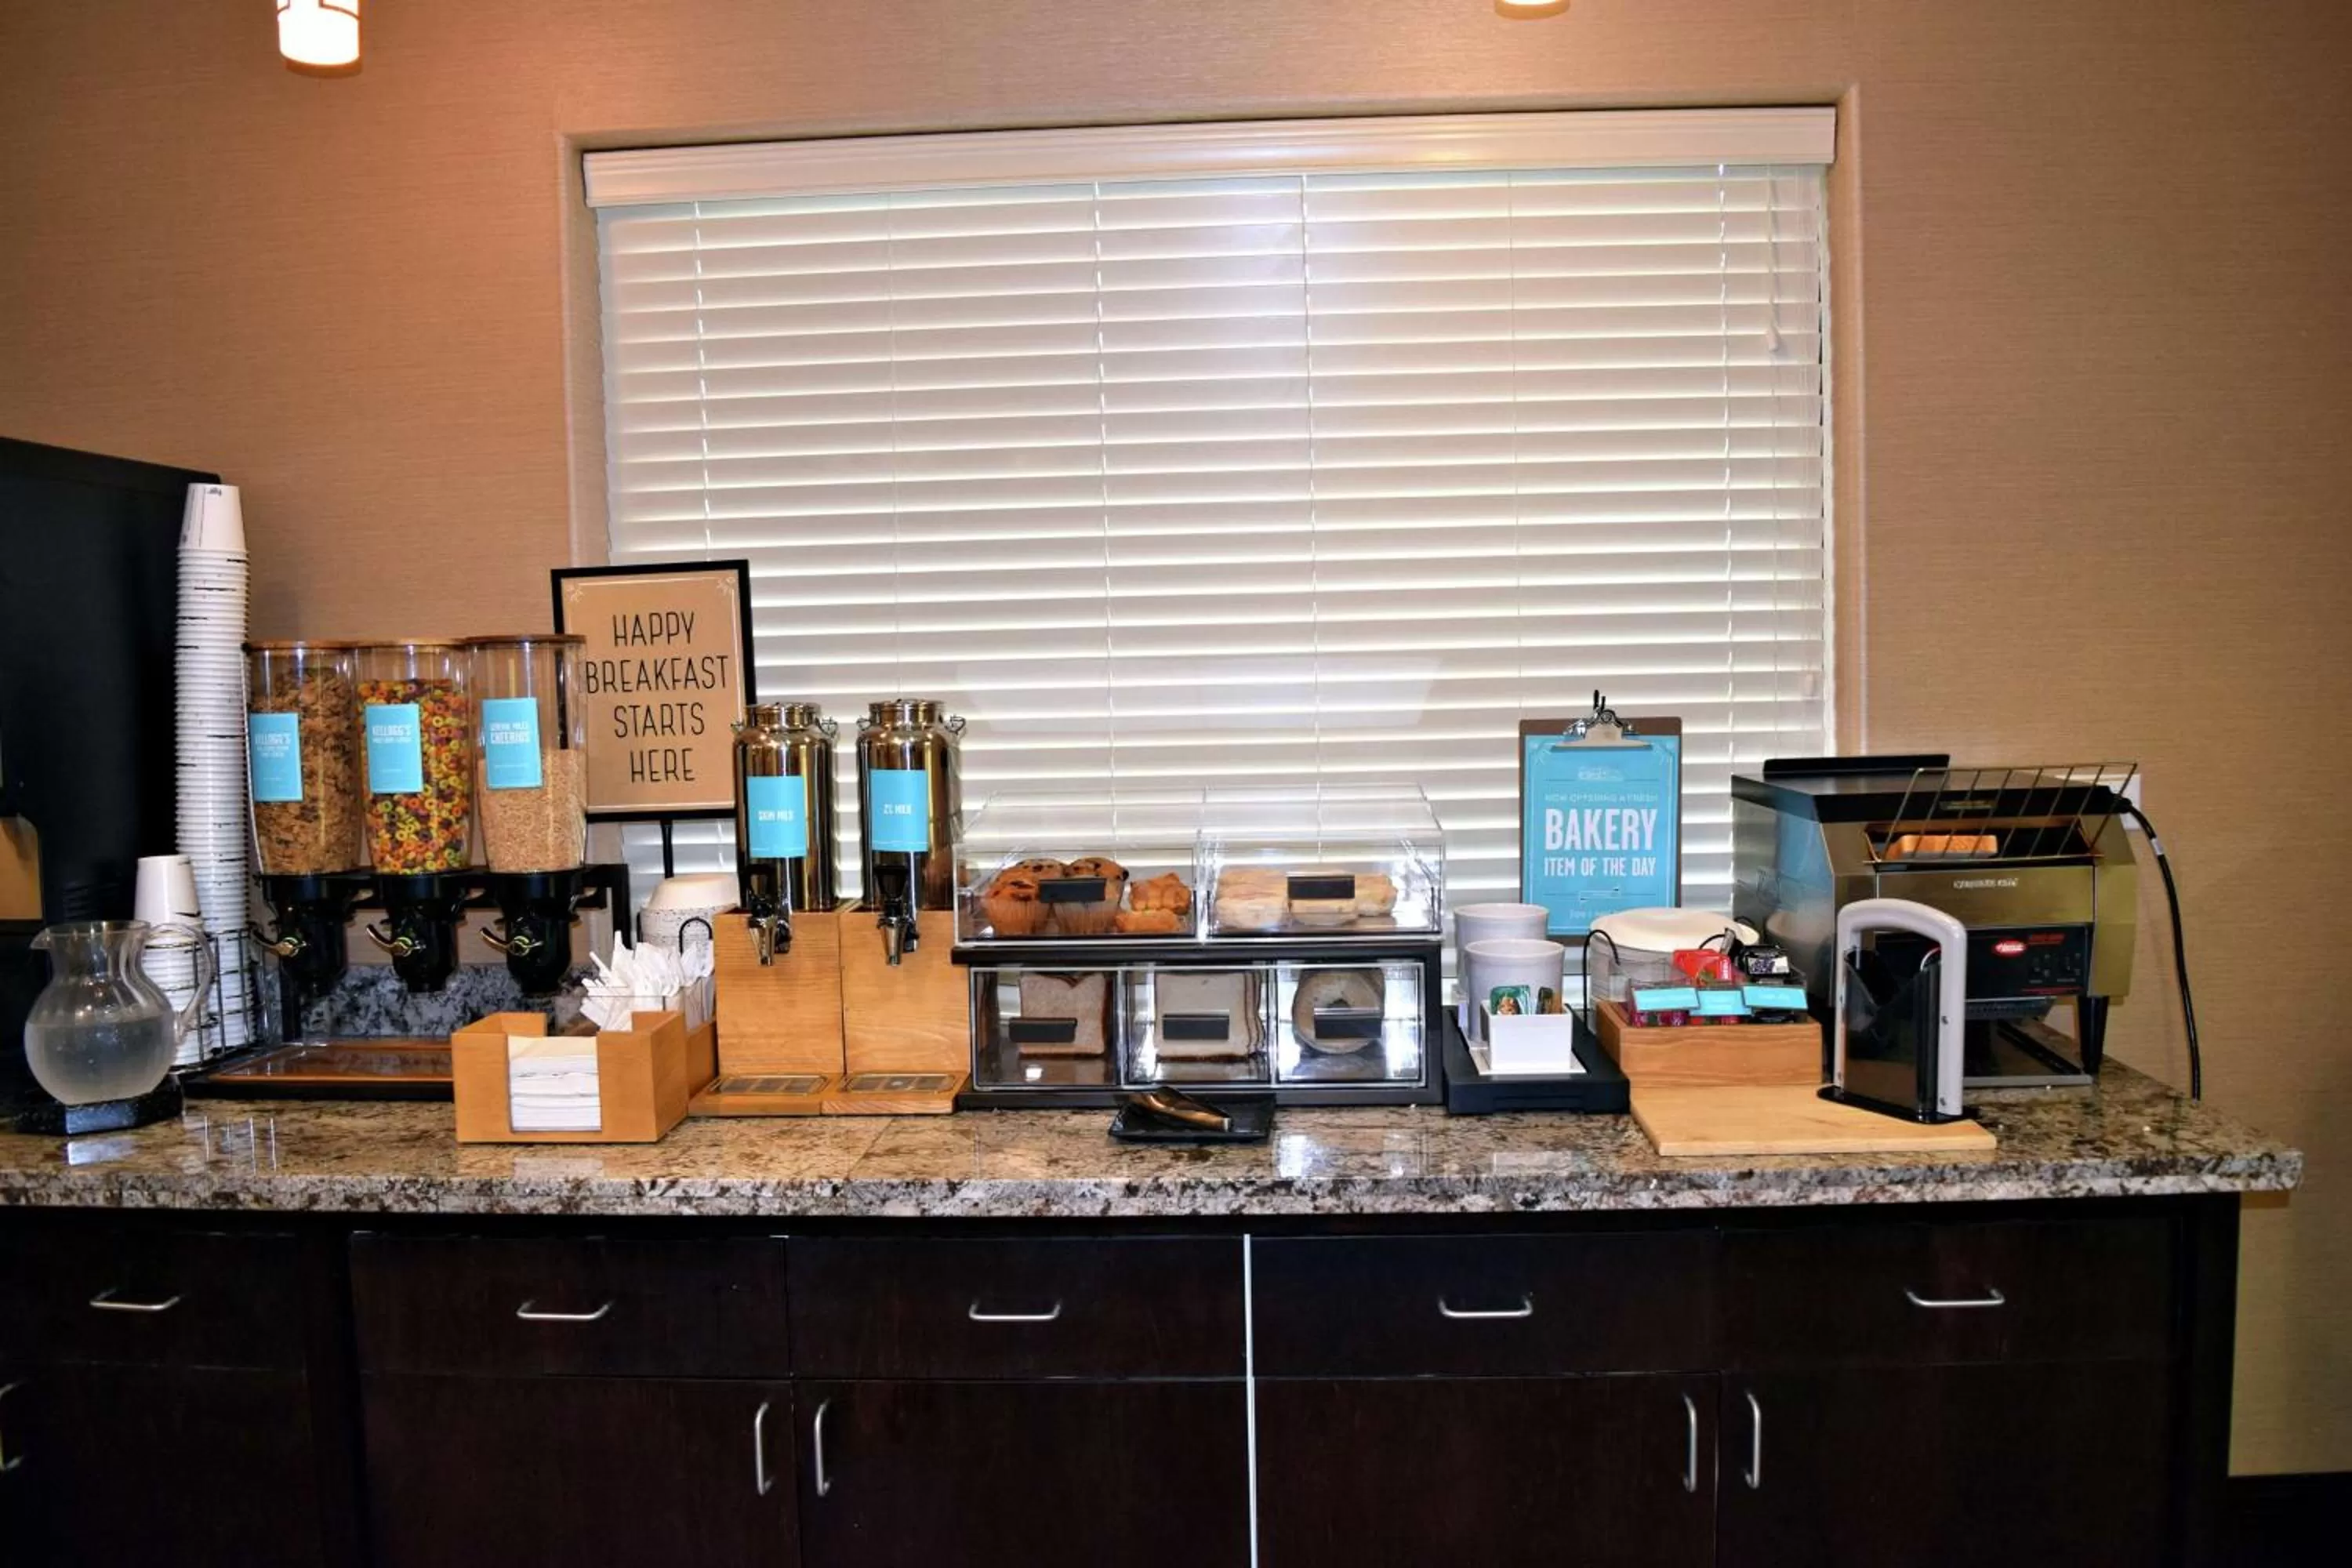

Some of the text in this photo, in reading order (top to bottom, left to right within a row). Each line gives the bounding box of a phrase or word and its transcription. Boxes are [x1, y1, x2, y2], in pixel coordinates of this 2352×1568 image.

[612, 611, 695, 647] HAPPY
[586, 655, 728, 694] BREAKFAST
[614, 702, 705, 738] STARTS
[630, 748, 696, 782] HERE
[1545, 808, 1657, 851] BAKERY
[1544, 857, 1656, 877] ITEM OF THE DAY
